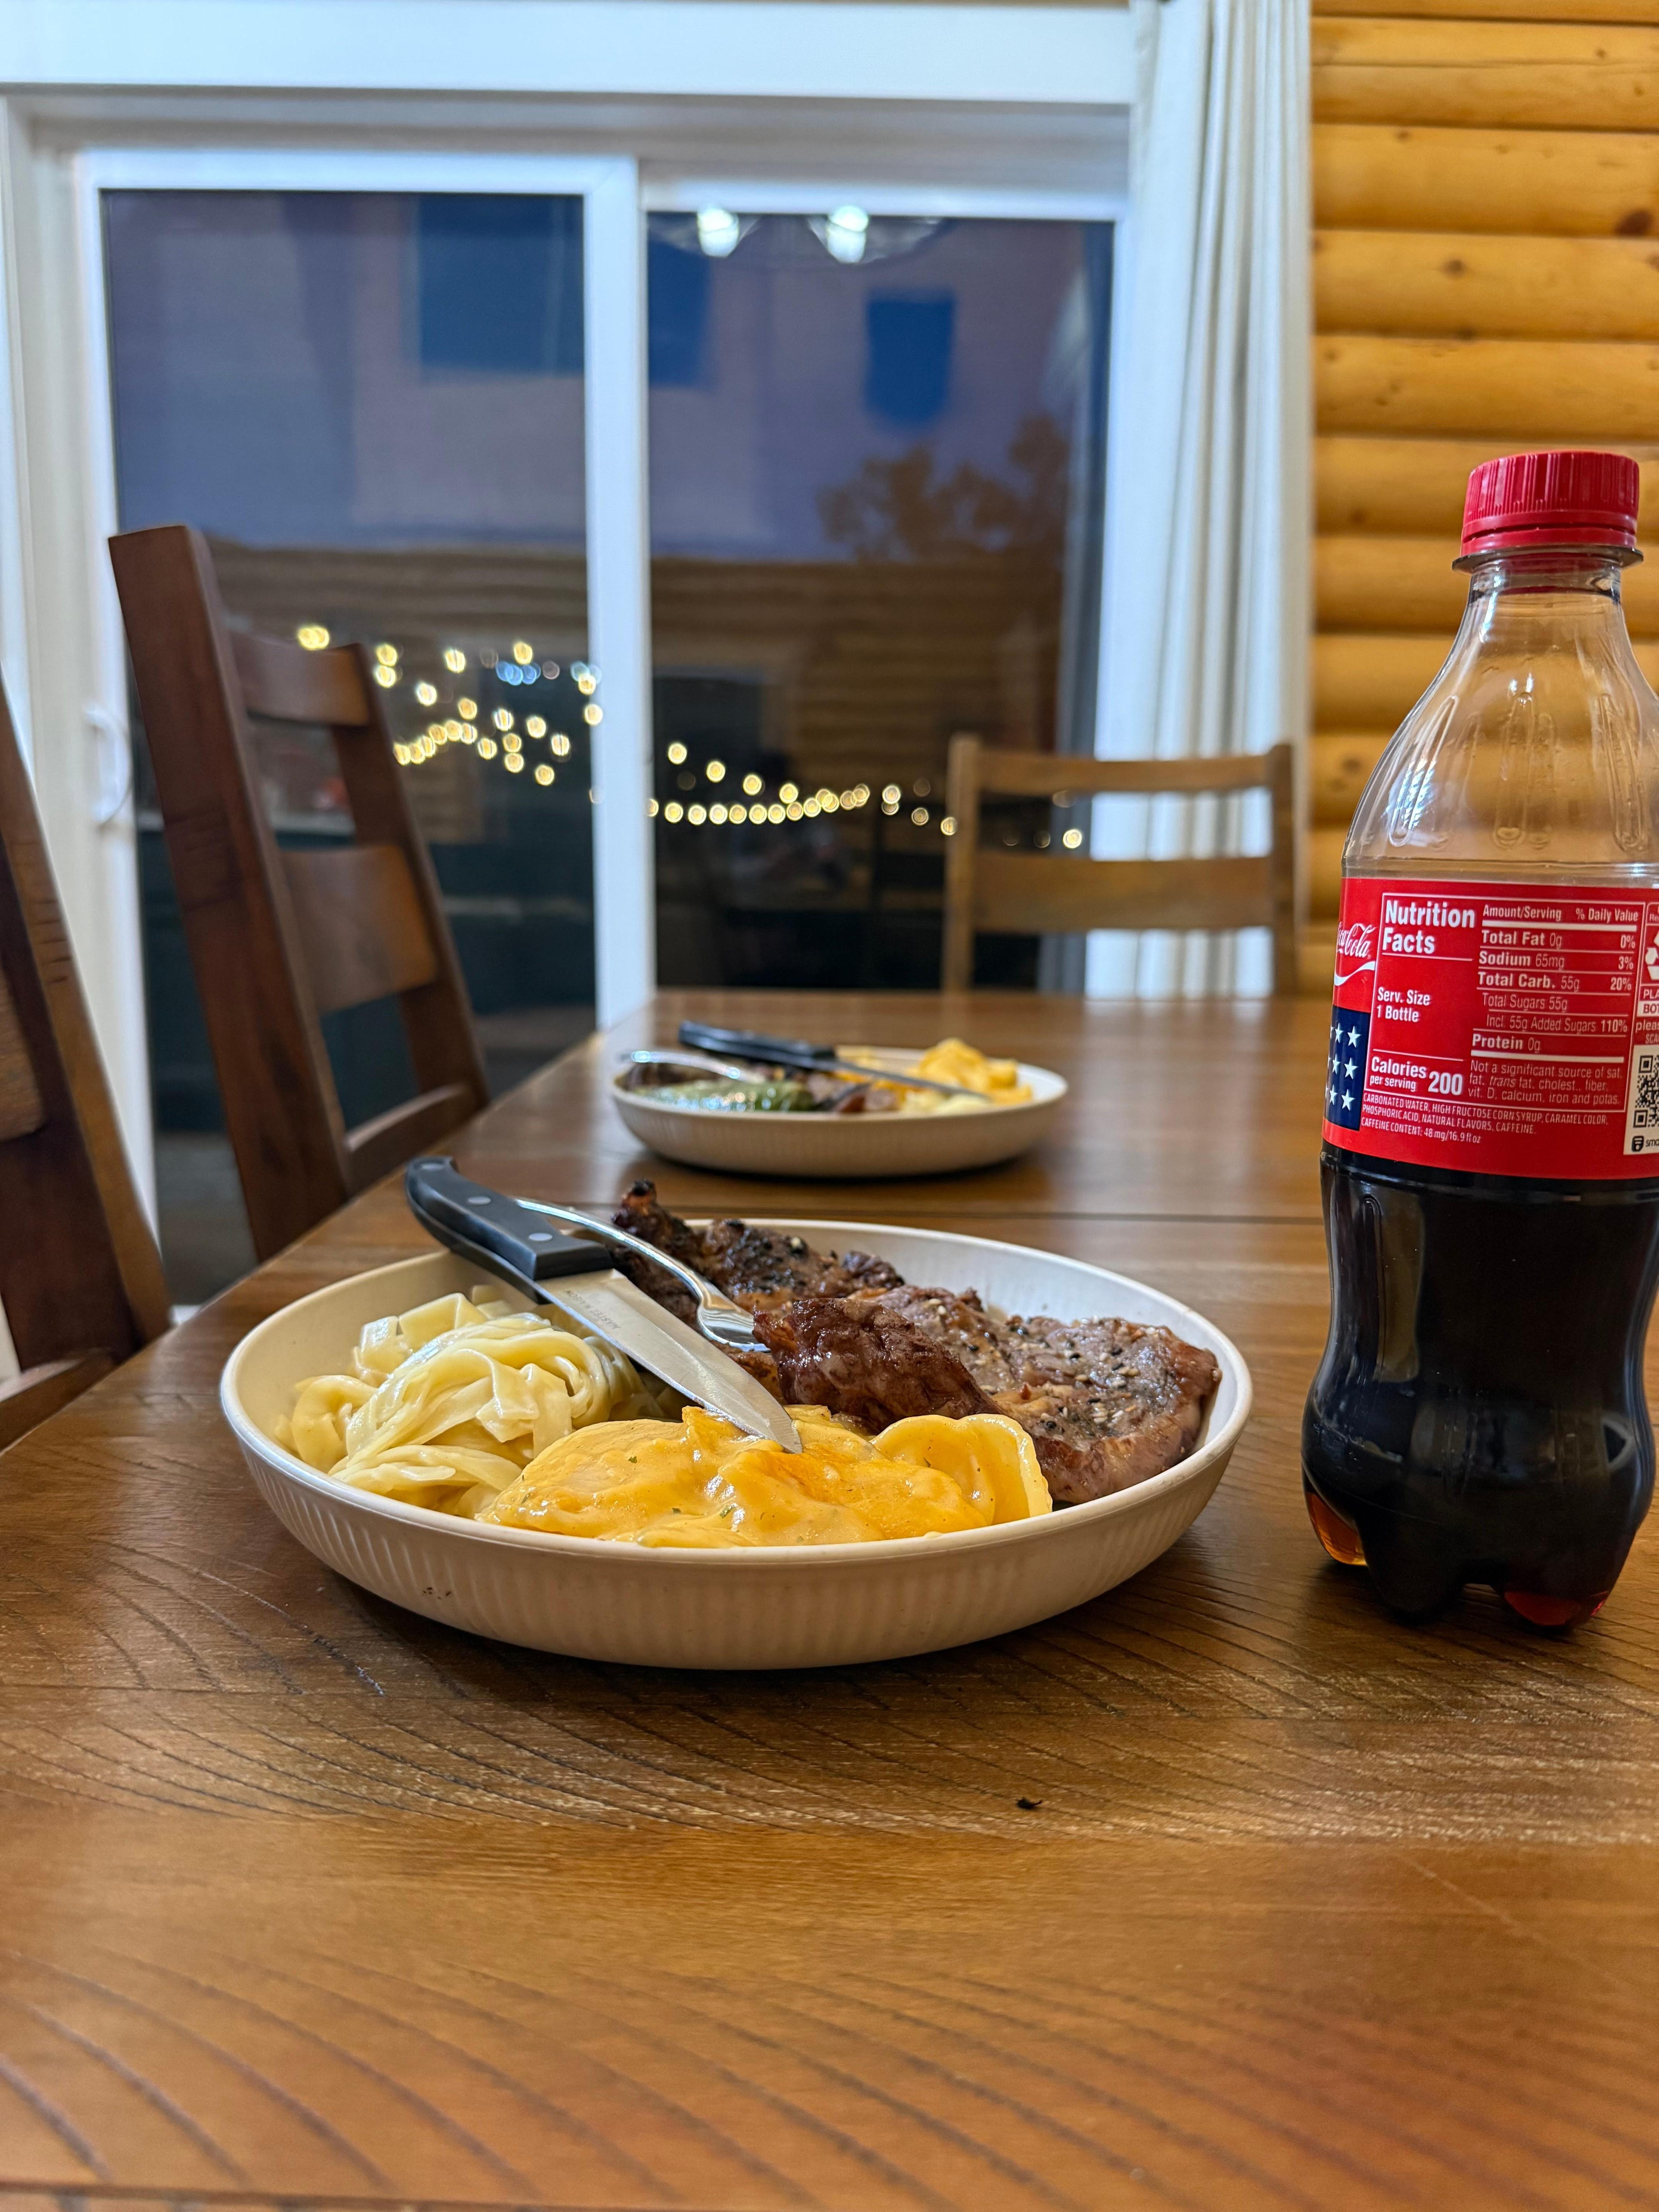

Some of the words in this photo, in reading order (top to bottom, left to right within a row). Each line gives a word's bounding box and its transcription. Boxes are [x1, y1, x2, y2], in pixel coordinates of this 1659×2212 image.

[1385, 900, 1475, 928] Nutrition
[1483, 904, 1562, 922] Amount/Serving
[1575, 908, 1585, 921] %
[1588, 908, 1611, 923] Daily
[1614, 908, 1638, 922] Value
[1382, 927, 1435, 954] Facts
[1482, 929, 1516, 945] Total
[1522, 932, 1545, 946] Fat
[1549, 933, 1562, 950] 0g
[1620, 934, 1635, 949] 0%
[1478, 951, 1531, 966] Sodium
[1535, 953, 1565, 971] 65mg
[1618, 956, 1633, 970] 3%
[1478, 972, 1513, 987] Total
[1518, 974, 1556, 989] Carb.
[1561, 976, 1580, 993] 55g
[1610, 977, 1632, 991] 20%
[1377, 987, 1403, 1003] Serv.
[1406, 989, 1431, 1006] Size
[1482, 992, 1506, 1007] Total
[1510, 994, 1545, 1012] Sugars
[1549, 996, 1568, 1013] 55g
[1377, 1005, 1381, 1018] 1
[1385, 1005, 1419, 1023] Bottle
[1509, 1015, 1528, 1032] 55g
[1530, 1016, 1561, 1031] Added
[1564, 1017, 1596, 1035] Sugars
[1601, 1019, 1628, 1033] 110%
[1472, 1034, 1523, 1050] Protein
[1528, 1037, 1541, 1054] 0g
[1371, 1056, 1427, 1079] Calories
[1427, 1071, 1463, 1096] 200
[1470, 1060, 1488, 1072] Not
[1491, 1064, 1498, 1073] a
[1501, 1063, 1555, 1077] significant
[1558, 1067, 1592, 1079] source
[1595, 1066, 1604, 1079] of
[1607, 1067, 1623, 1079] sat.
[1369, 1075, 1383, 1086] per
[1384, 1077, 1417, 1092] serving
[1489, 1075, 1516, 1088] trans
[1468, 1086, 1483, 1098] vit.
[1549, 1091, 1569, 1103] iron
[1572, 1092, 1590, 1104] and
[1364, 1093, 1404, 1108] CARBONATED
[1405, 1099, 1431, 1113] WATER,
[1432, 1103, 1451, 1115] HIGH
[1452, 1106, 1492, 1119] FRUCTOSE
[1492, 1110, 1515, 1121] CORN
[1545, 1113, 1581, 1124] CARAMEL
[1362, 1104, 1403, 1120] PHOSPHORIC
[1403, 1111, 1420, 1123] ACID,
[1422, 1113, 1456, 1127] NATURAL
[1496, 1122, 1537, 1134] CAFFEINE.
[1361, 1117, 1390, 1131] CAFFEINE
[1390, 1122, 1422, 1136] CONTENT:
[1424, 1127, 1433, 1138] 48
[1434, 1130, 1465, 1142] mg/16.9
[1466, 1132, 1472, 1143] fl
[1472, 1135, 1481, 1144] oz
